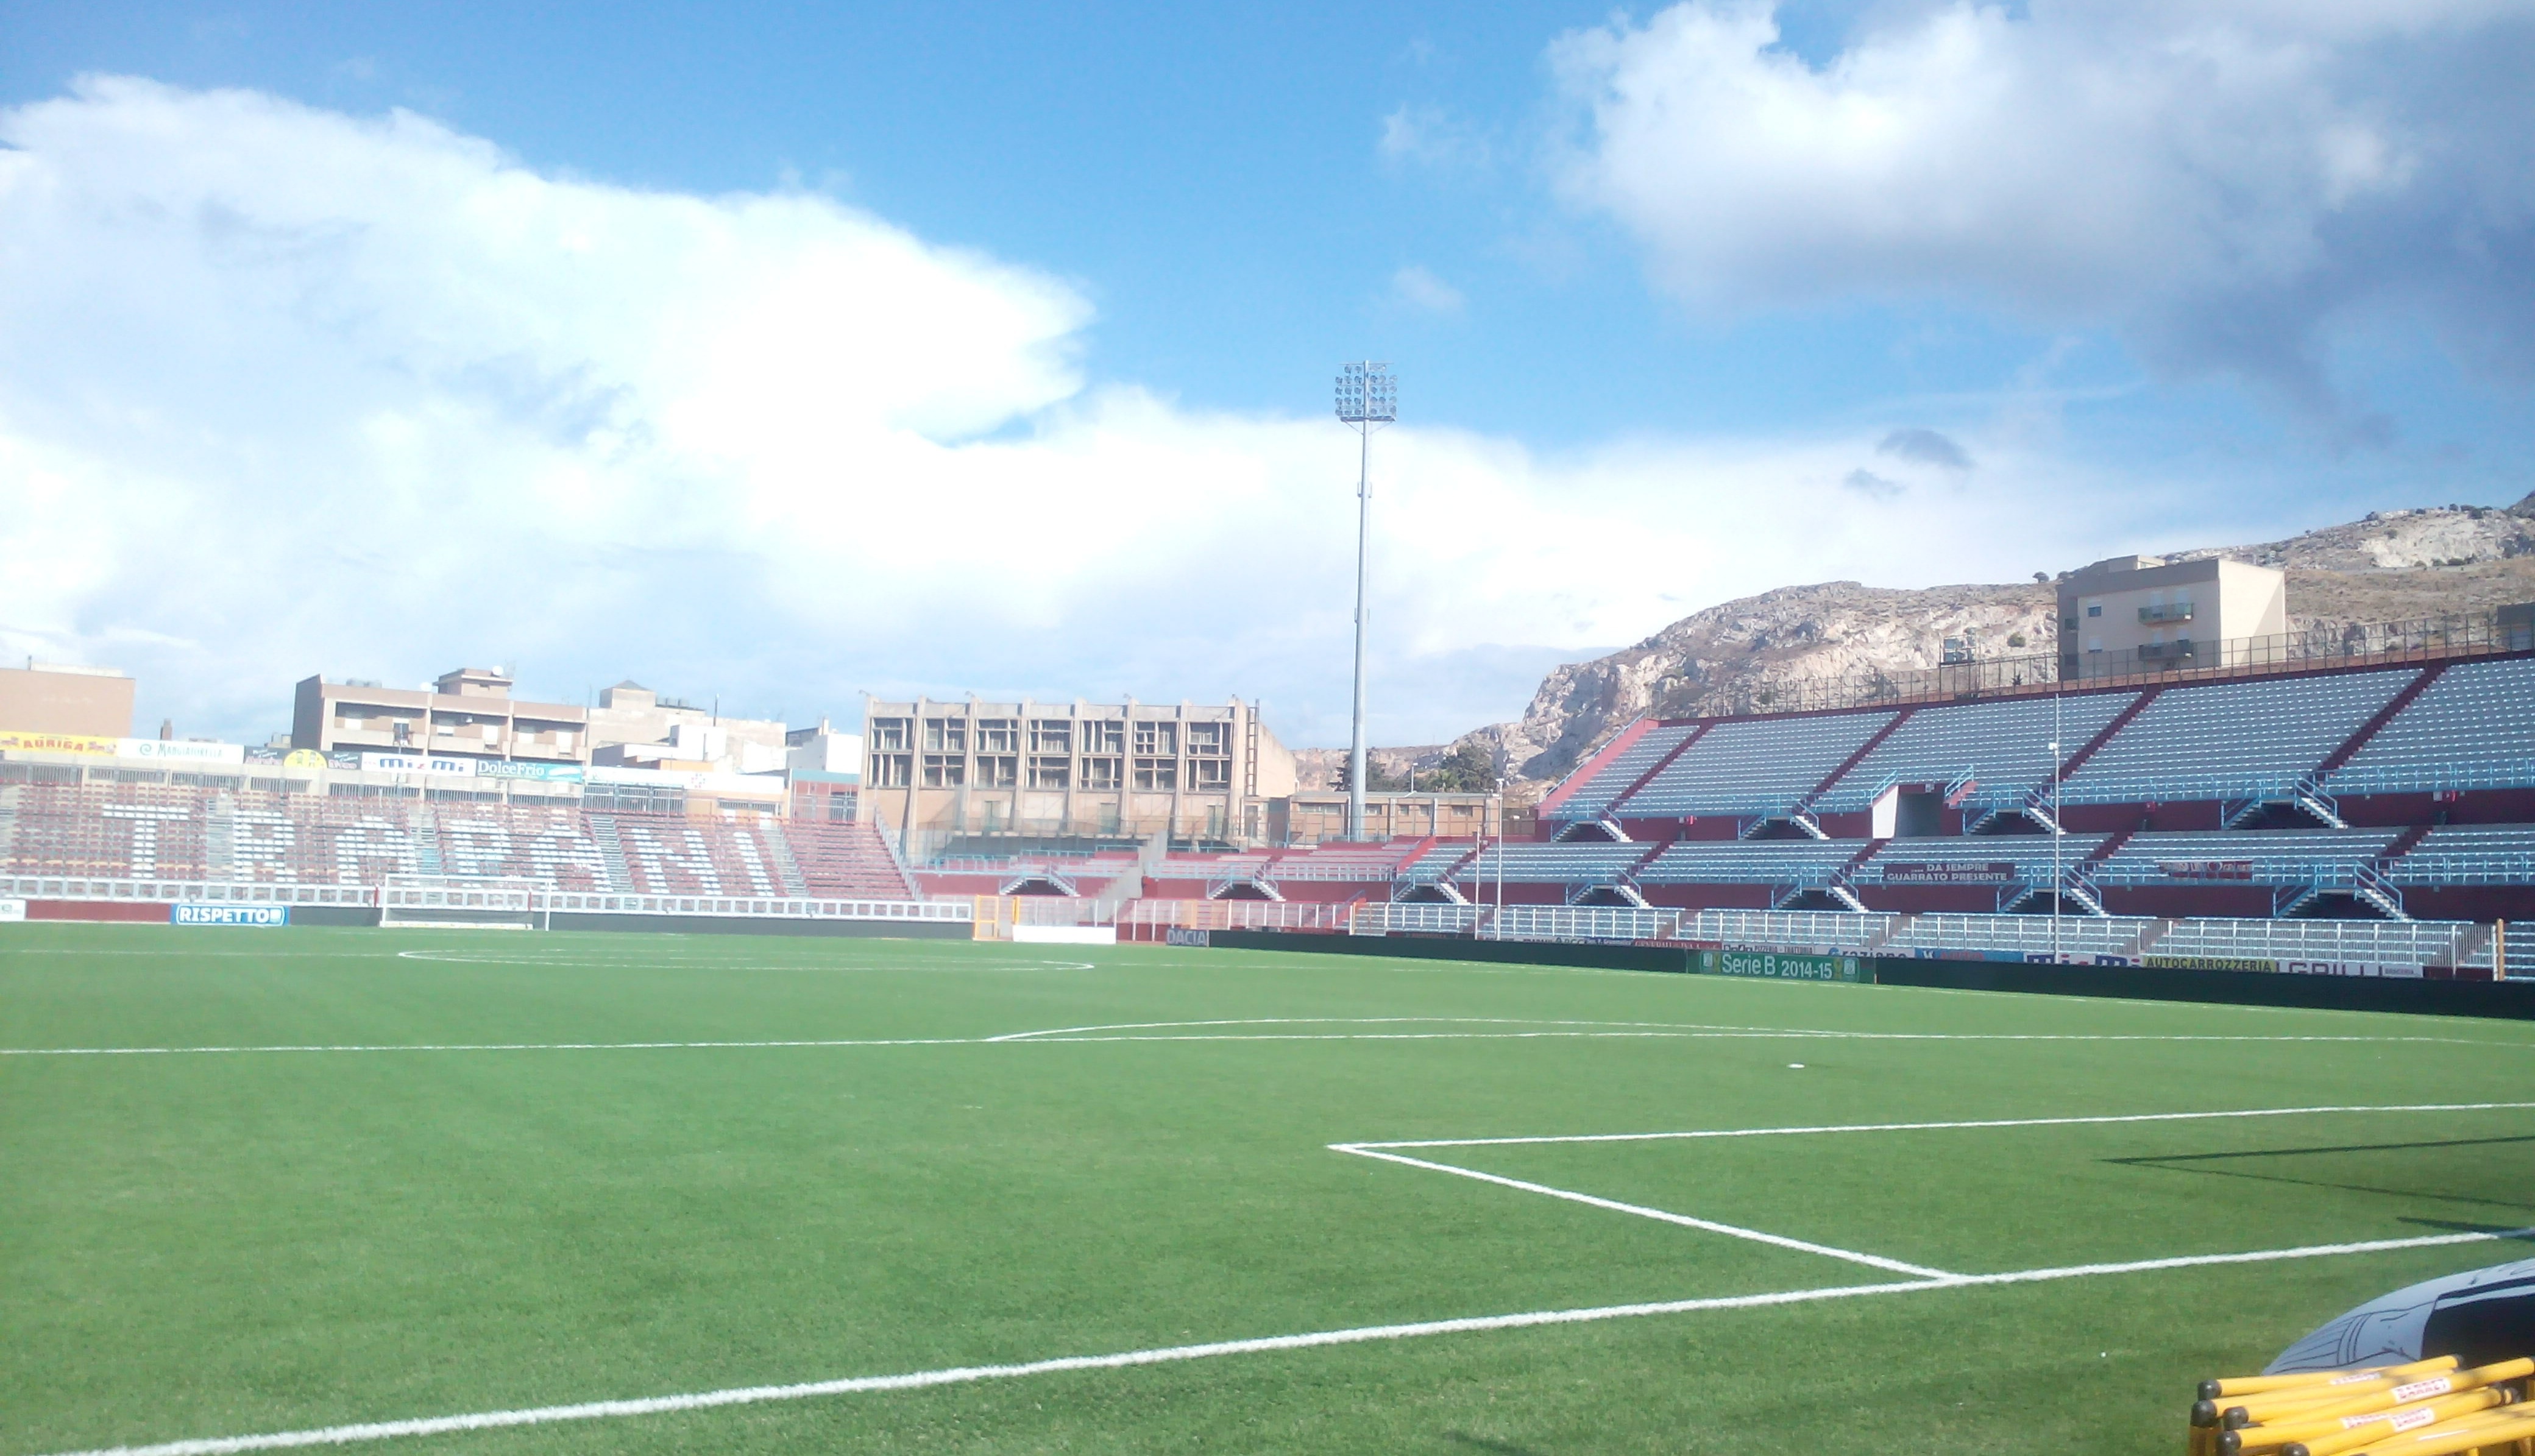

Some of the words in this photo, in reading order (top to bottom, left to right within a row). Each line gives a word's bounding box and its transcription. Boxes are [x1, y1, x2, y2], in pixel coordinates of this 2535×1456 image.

[23, 739, 84, 752] AURIGA
[478, 760, 545, 776] DolceFrio
[102, 803, 776, 897] TRAPANI
[1946, 863, 1989, 872] SEMPRE
[1951, 872, 2007, 881] PRESENTE
[179, 906, 270, 924] RISPETTO
[1166, 929, 1206, 945] DACIA
[1722, 953, 1761, 974] Serie
[1764, 955, 1776, 975] B
[1781, 960, 1832, 979] 2014-15
[2147, 957, 2272, 972] AUTOCARROZZERIA
